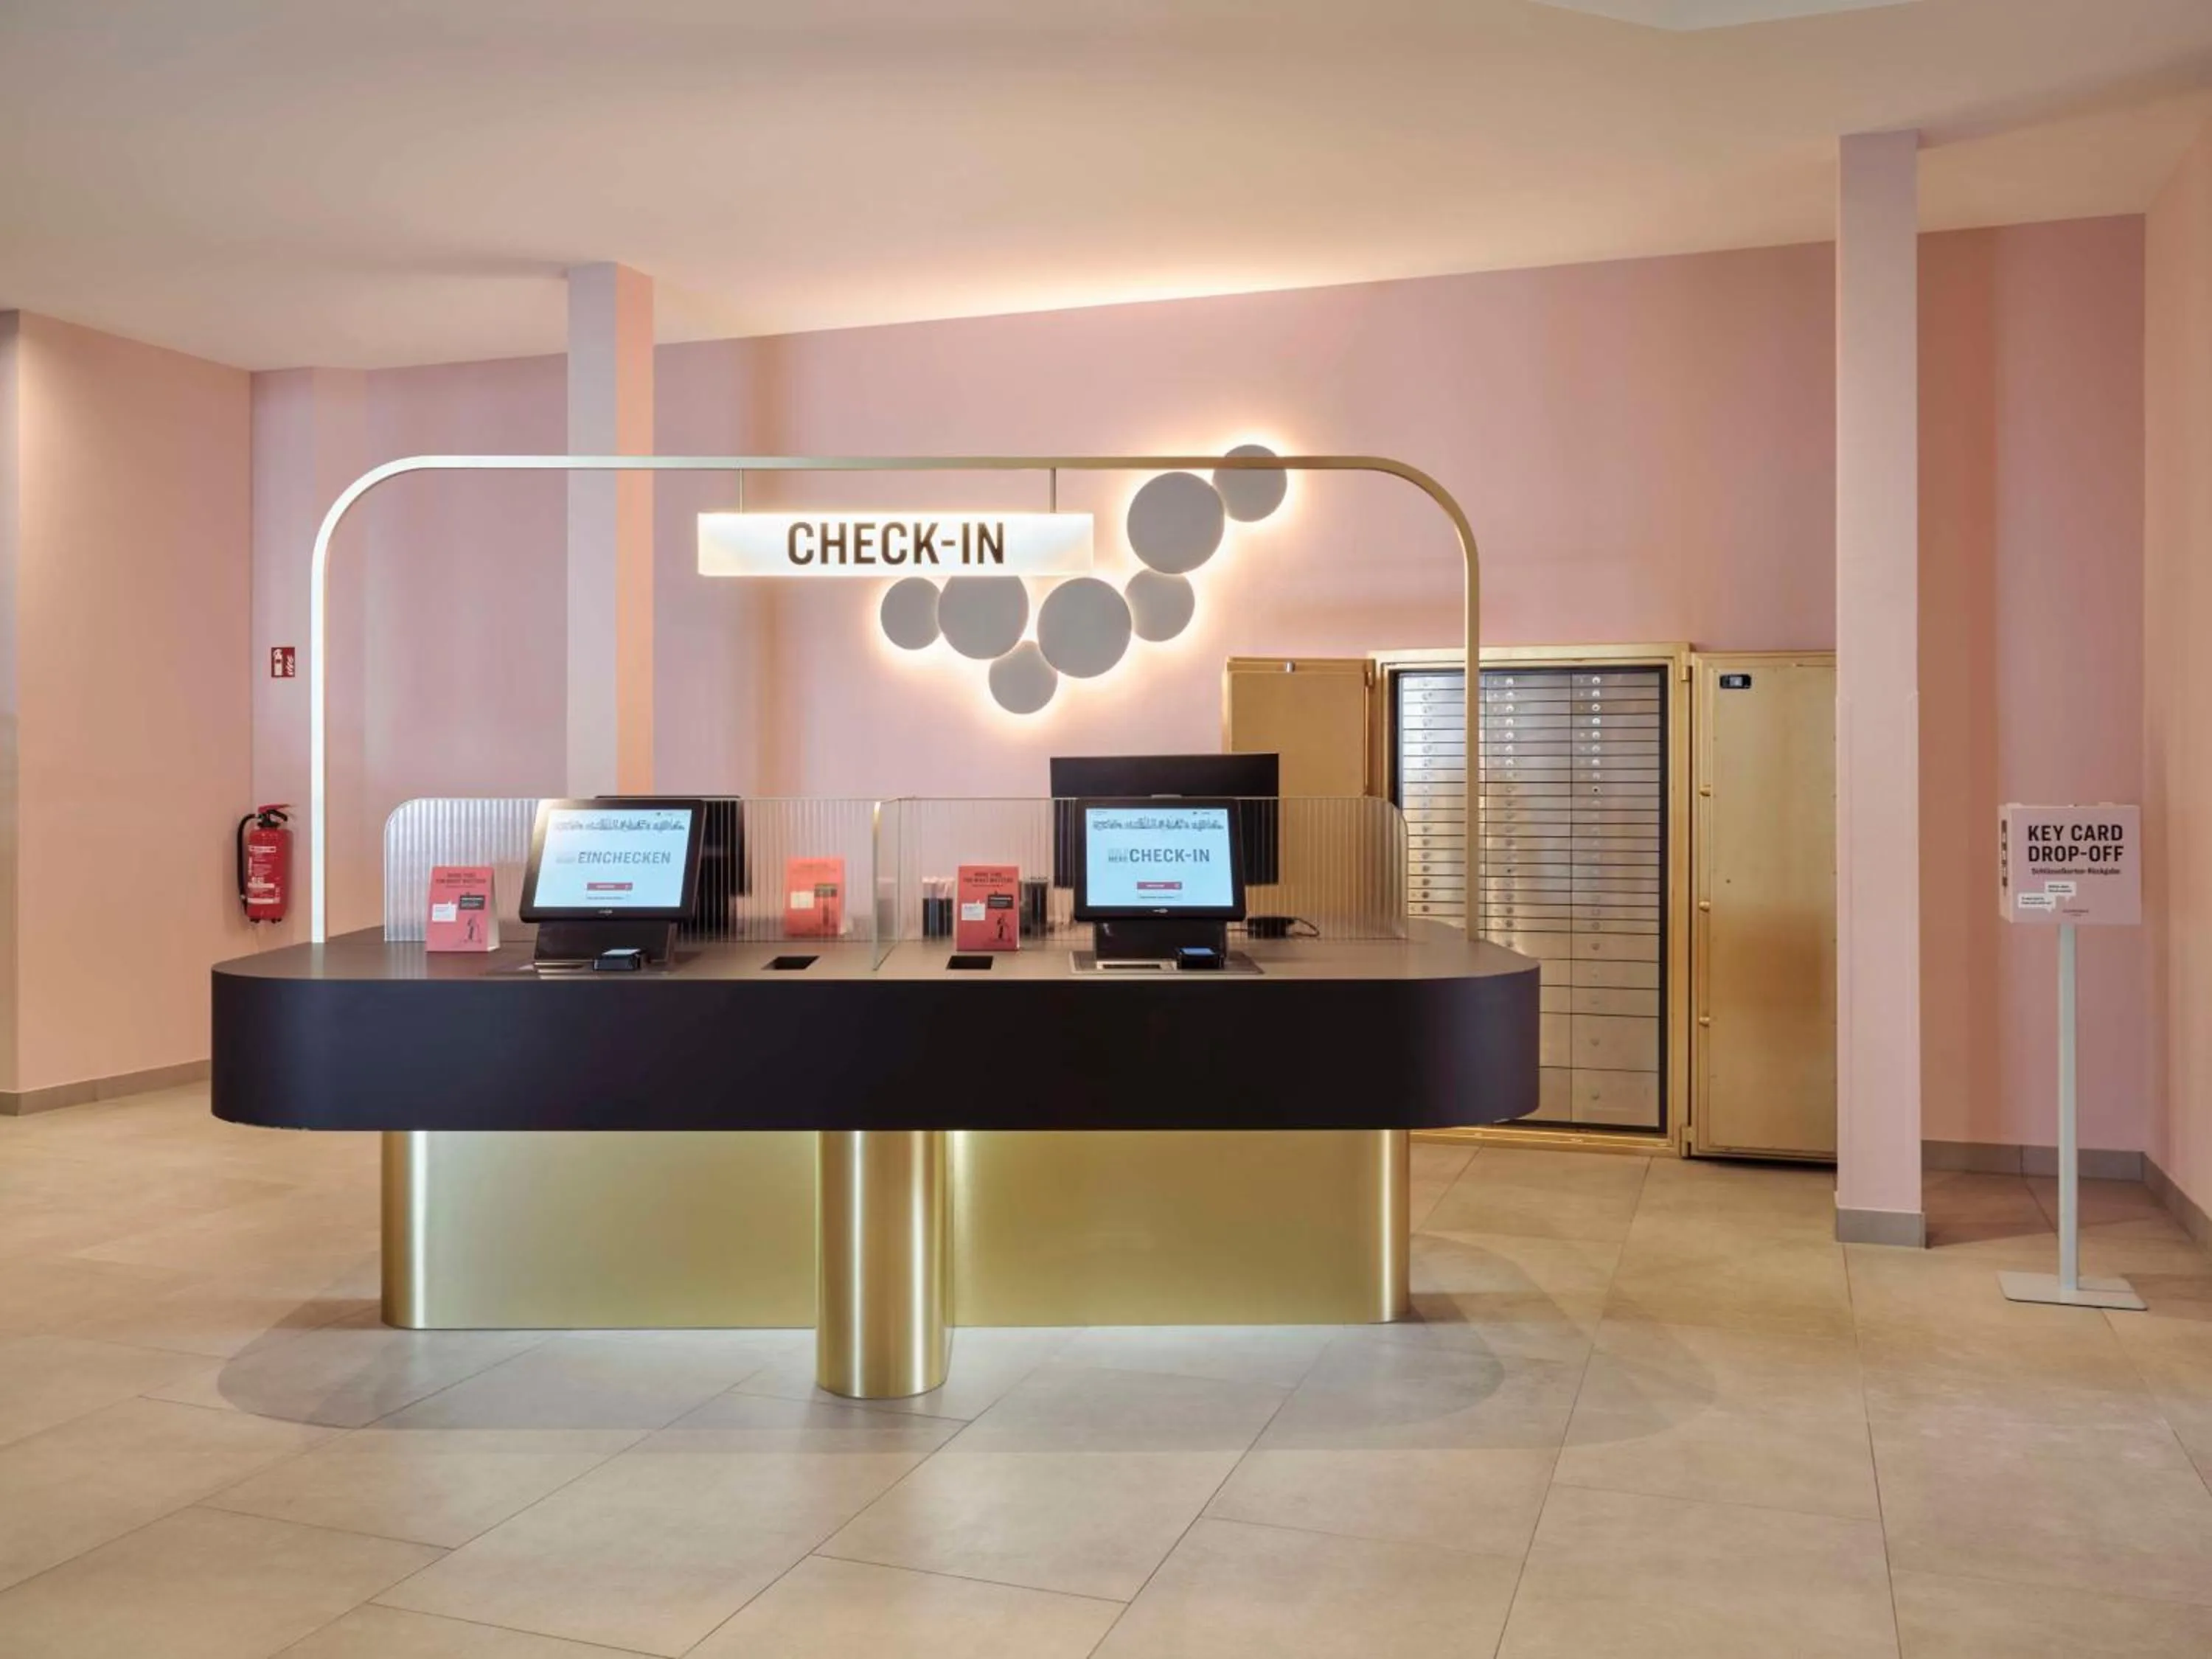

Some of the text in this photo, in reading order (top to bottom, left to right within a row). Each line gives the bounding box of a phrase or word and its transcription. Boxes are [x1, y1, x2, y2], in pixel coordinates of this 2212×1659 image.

[787, 521, 1004, 565] CHECK-IN
[2028, 824, 2123, 841] KEY CARD
[578, 851, 671, 864] EINCHECKEN
[1130, 849, 1210, 863] CHECK-IN
[2028, 846, 2124, 862] DROP-OFF
